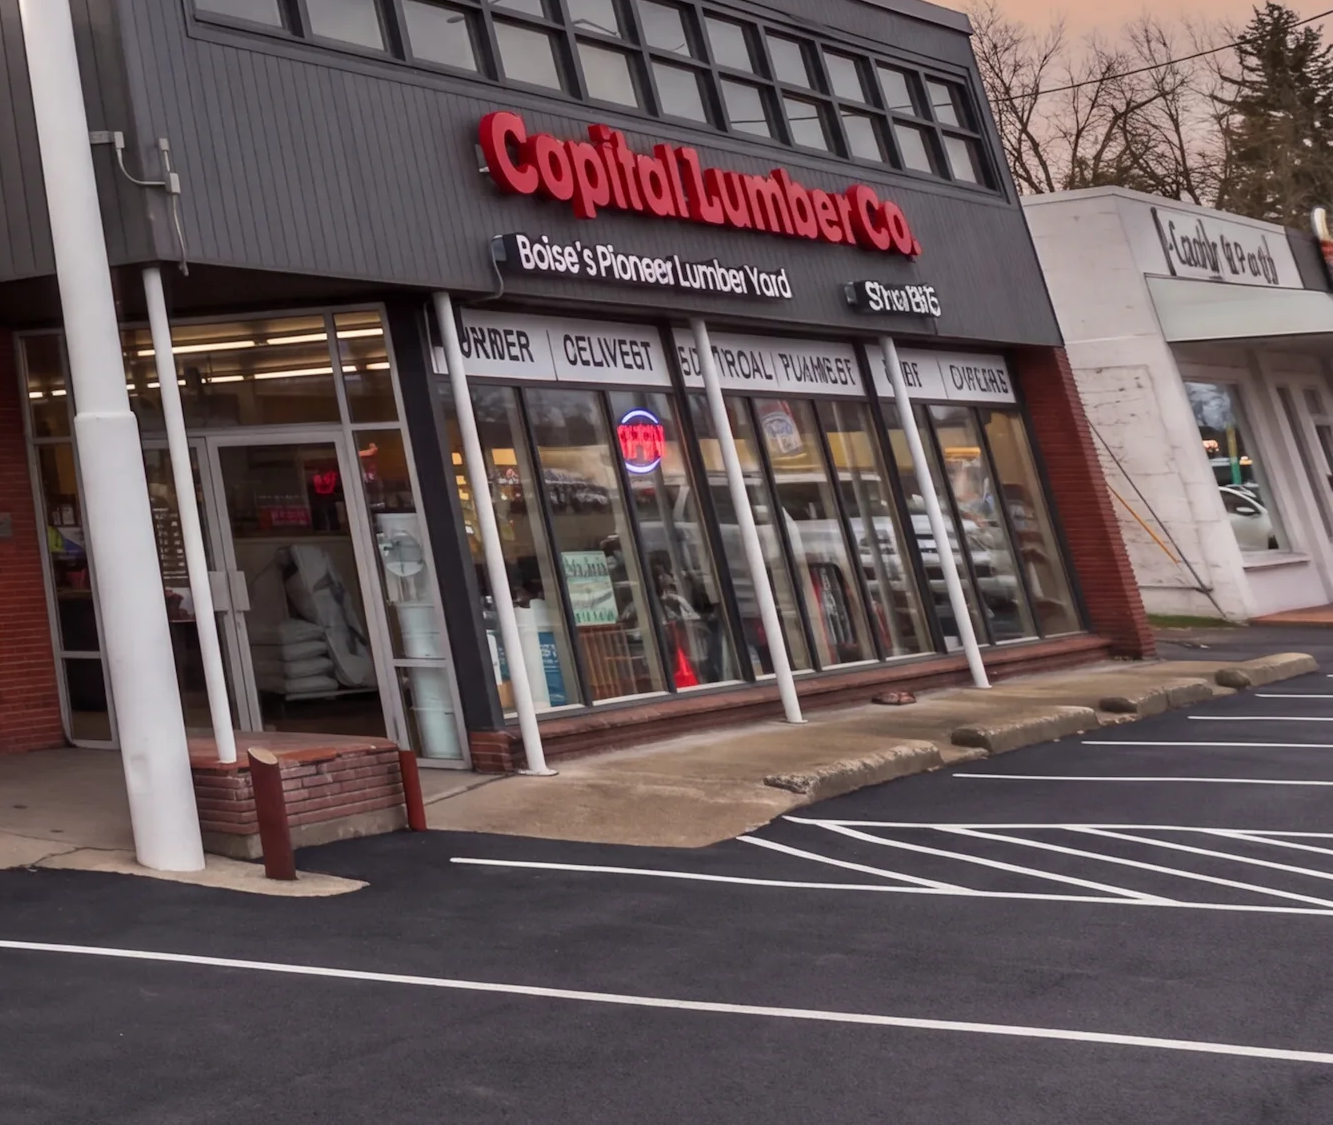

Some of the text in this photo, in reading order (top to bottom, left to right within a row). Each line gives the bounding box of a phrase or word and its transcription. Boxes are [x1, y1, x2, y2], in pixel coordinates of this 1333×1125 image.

[678, 146, 857, 246] Lumber
[848, 184, 922, 258] Co.
[515, 234, 793, 299] Boise's Pioneer Lumber Yard
